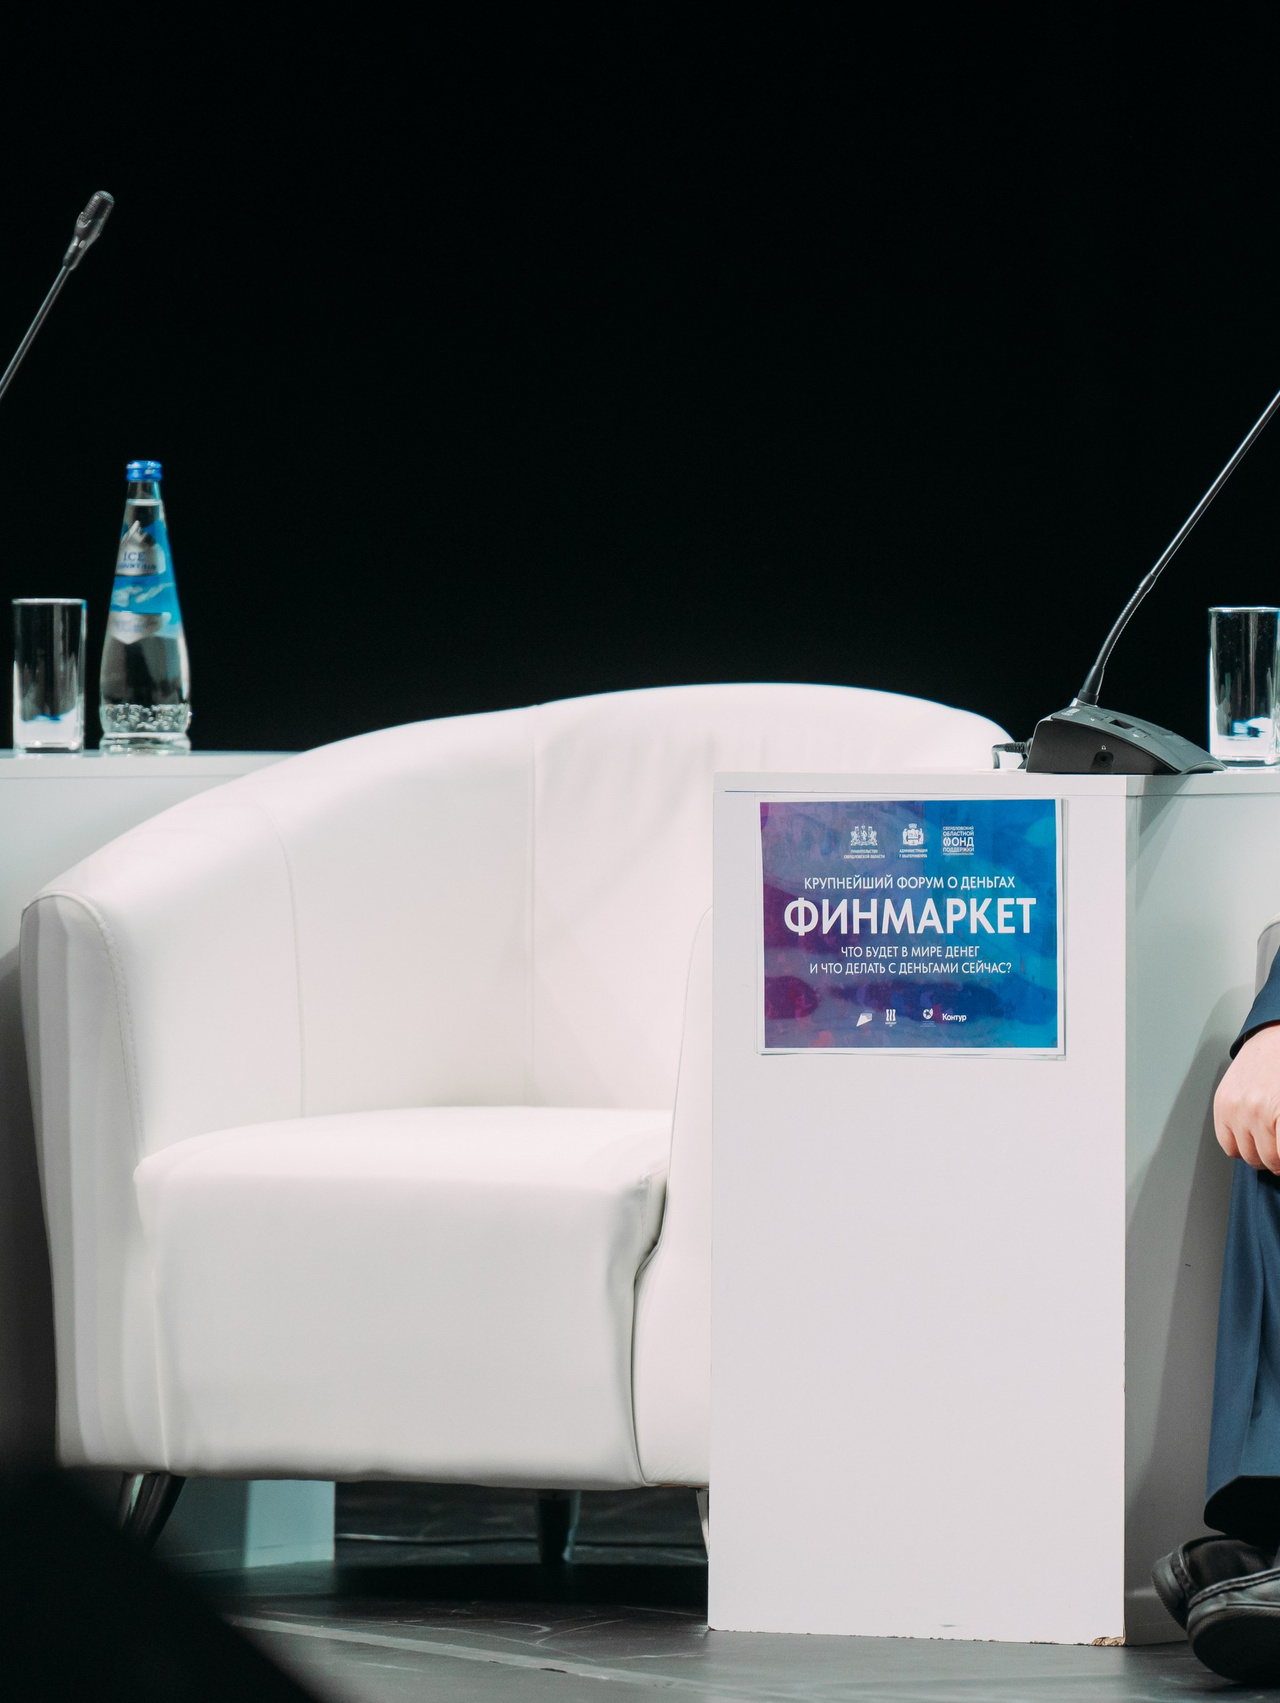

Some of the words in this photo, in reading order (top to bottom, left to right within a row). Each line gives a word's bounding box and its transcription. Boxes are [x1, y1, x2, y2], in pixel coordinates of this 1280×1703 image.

[124, 551, 147, 561] ICE
[943, 837, 974, 848] ФОНД
[804, 874, 893, 890] КРУПНЕЙШИЙ
[896, 876, 944, 890] ФОРУМ
[947, 876, 958, 889] О
[961, 876, 1016, 890] ДЕНЬГАХ
[784, 897, 1037, 936] ФИНМАРКЕТ
[841, 946, 863, 958] ЧТО
[866, 946, 899, 959] БУДЕТ
[902, 946, 909, 957] В
[911, 946, 943, 957] МИРЕ
[945, 946, 980, 959] ДЕНЕГ
[809, 963, 818, 974] И
[821, 963, 843, 974] ЧТО
[845, 963, 886, 975] ДЕЛАТЬ
[888, 963, 897, 974] С
[899, 963, 959, 975] ДЕНЬГАМИ
[961, 960, 1012, 974] СЕЙЧАС?
[941, 1012, 967, 1023] Контур
